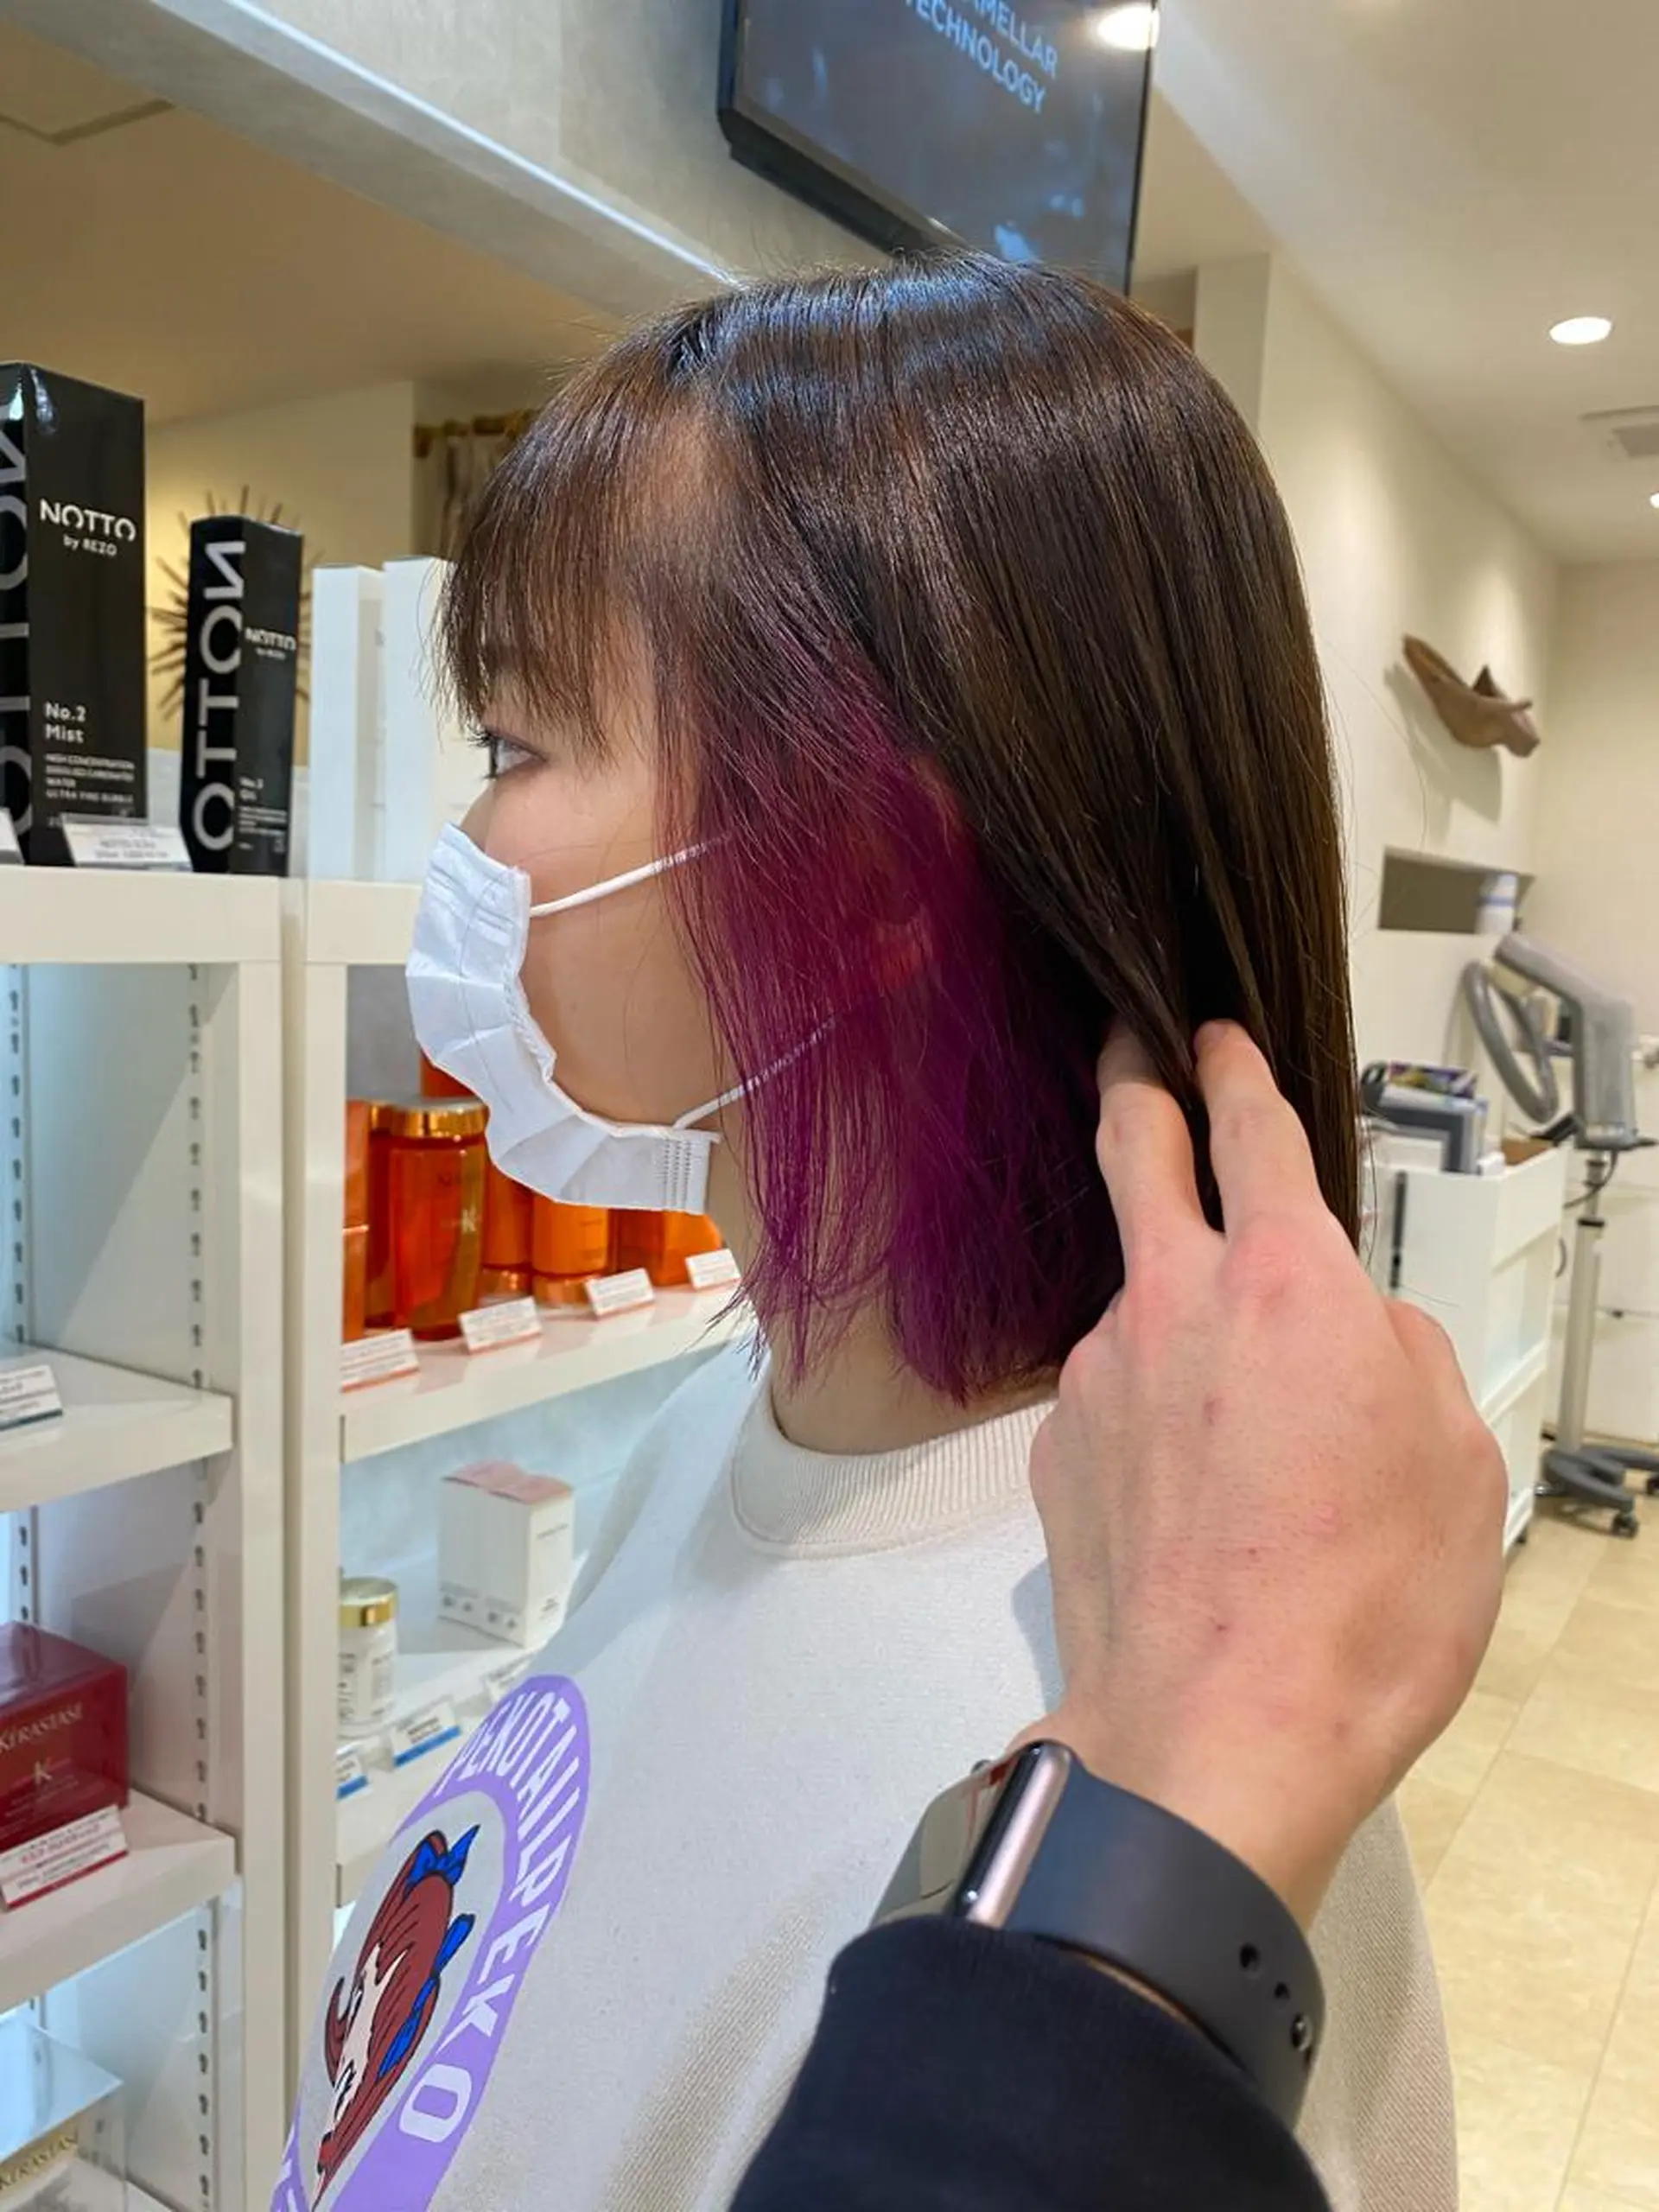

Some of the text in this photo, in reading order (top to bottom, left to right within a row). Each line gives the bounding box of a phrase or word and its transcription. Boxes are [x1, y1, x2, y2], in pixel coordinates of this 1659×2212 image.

[905, 0, 1046, 114] ECHNOLOGY
[40, 498, 137, 543] NOTTO
[45, 700, 87, 723] No.2
[45, 723, 85, 744] Mist
